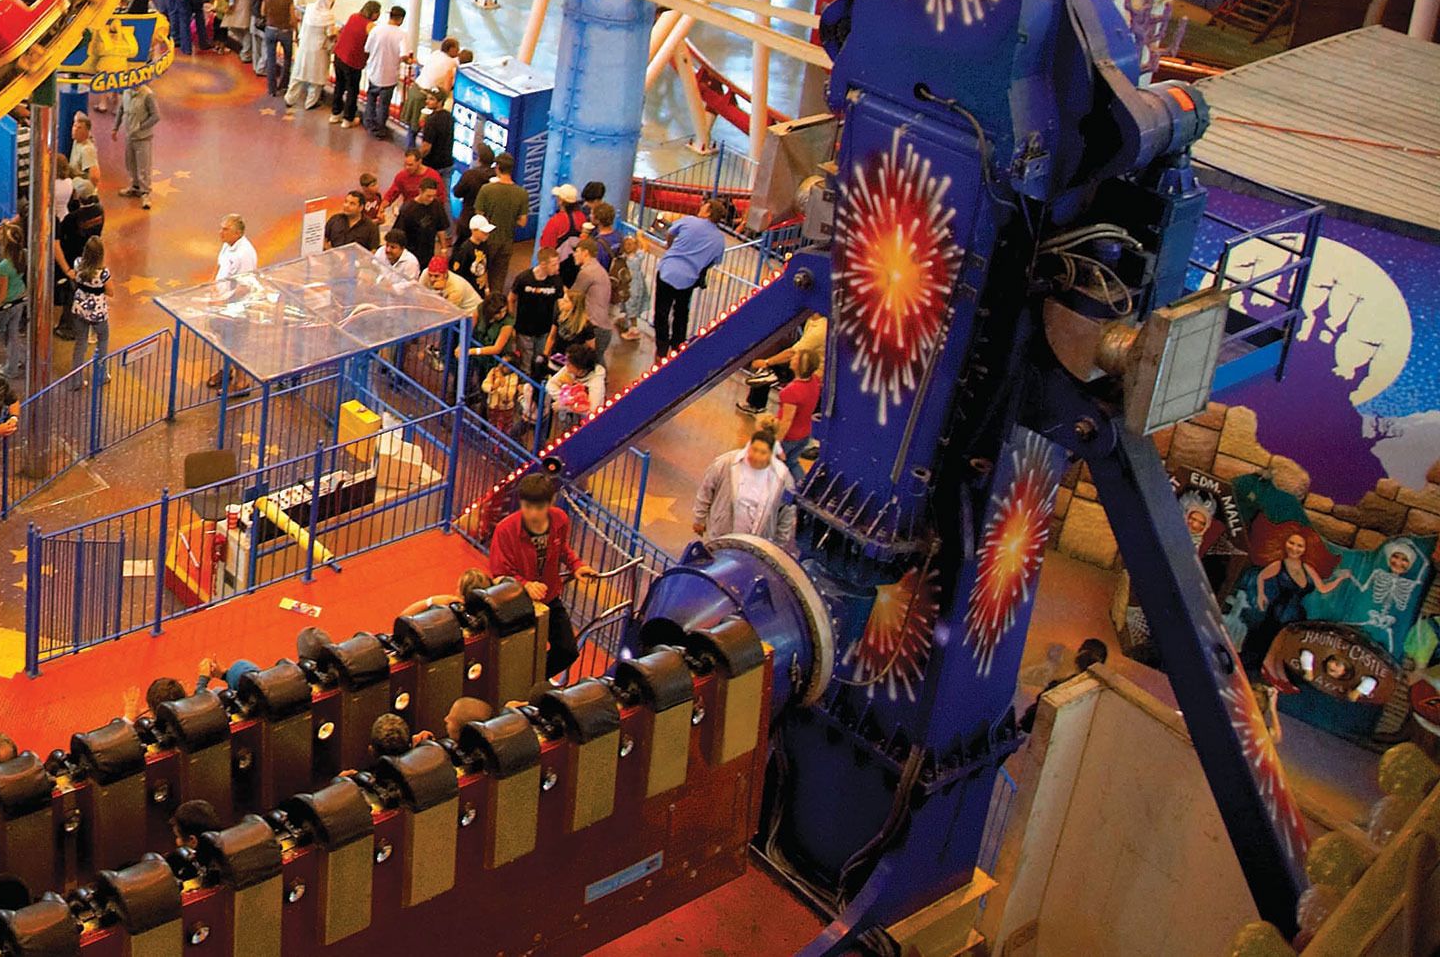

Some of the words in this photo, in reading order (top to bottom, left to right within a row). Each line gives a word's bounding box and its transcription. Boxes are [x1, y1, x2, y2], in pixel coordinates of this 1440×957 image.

[90, 64, 155, 92] GALAXY
[1190, 472, 1221, 494] EDM.
[1221, 495, 1242, 537] MALL
